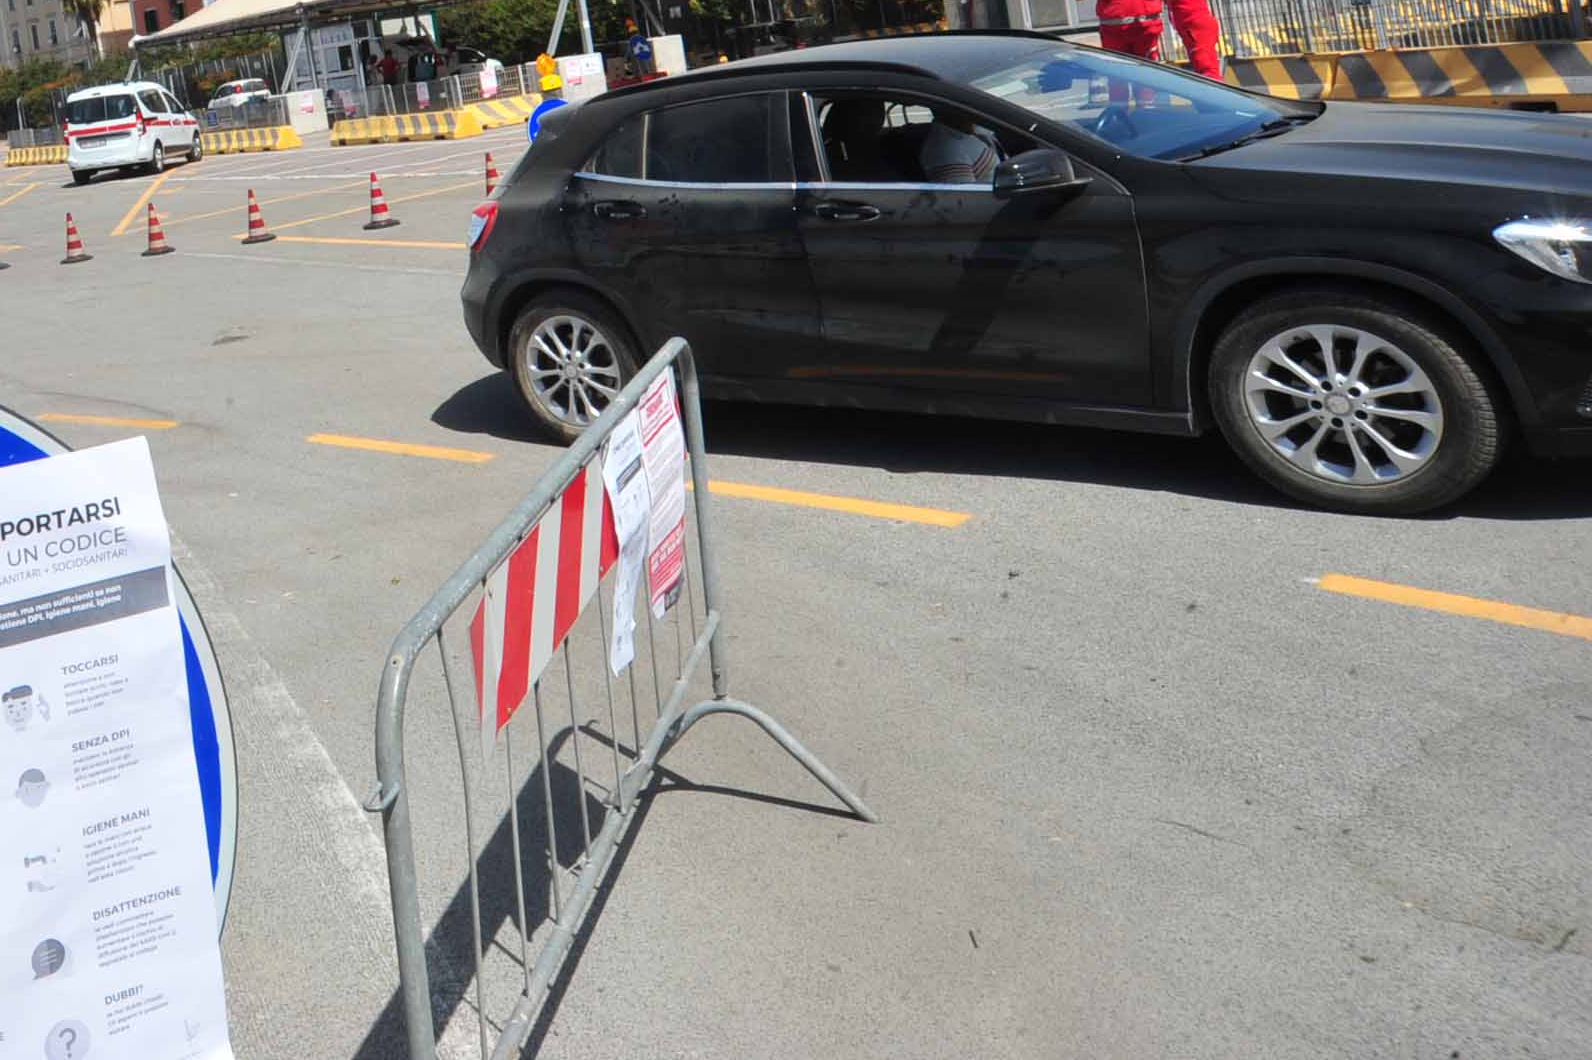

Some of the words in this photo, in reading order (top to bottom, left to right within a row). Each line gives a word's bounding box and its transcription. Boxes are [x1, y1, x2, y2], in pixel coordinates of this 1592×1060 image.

[6, 544, 38, 566] UN
[44, 526, 130, 558] CODICE
[60, 653, 118, 675] TOCCARSI
[71, 733, 110, 752] SENZA
[110, 727, 130, 742] DPI
[82, 816, 119, 836] IGIENE
[120, 807, 150, 824] MANI
[92, 885, 181, 921] DISATTENZIONE
